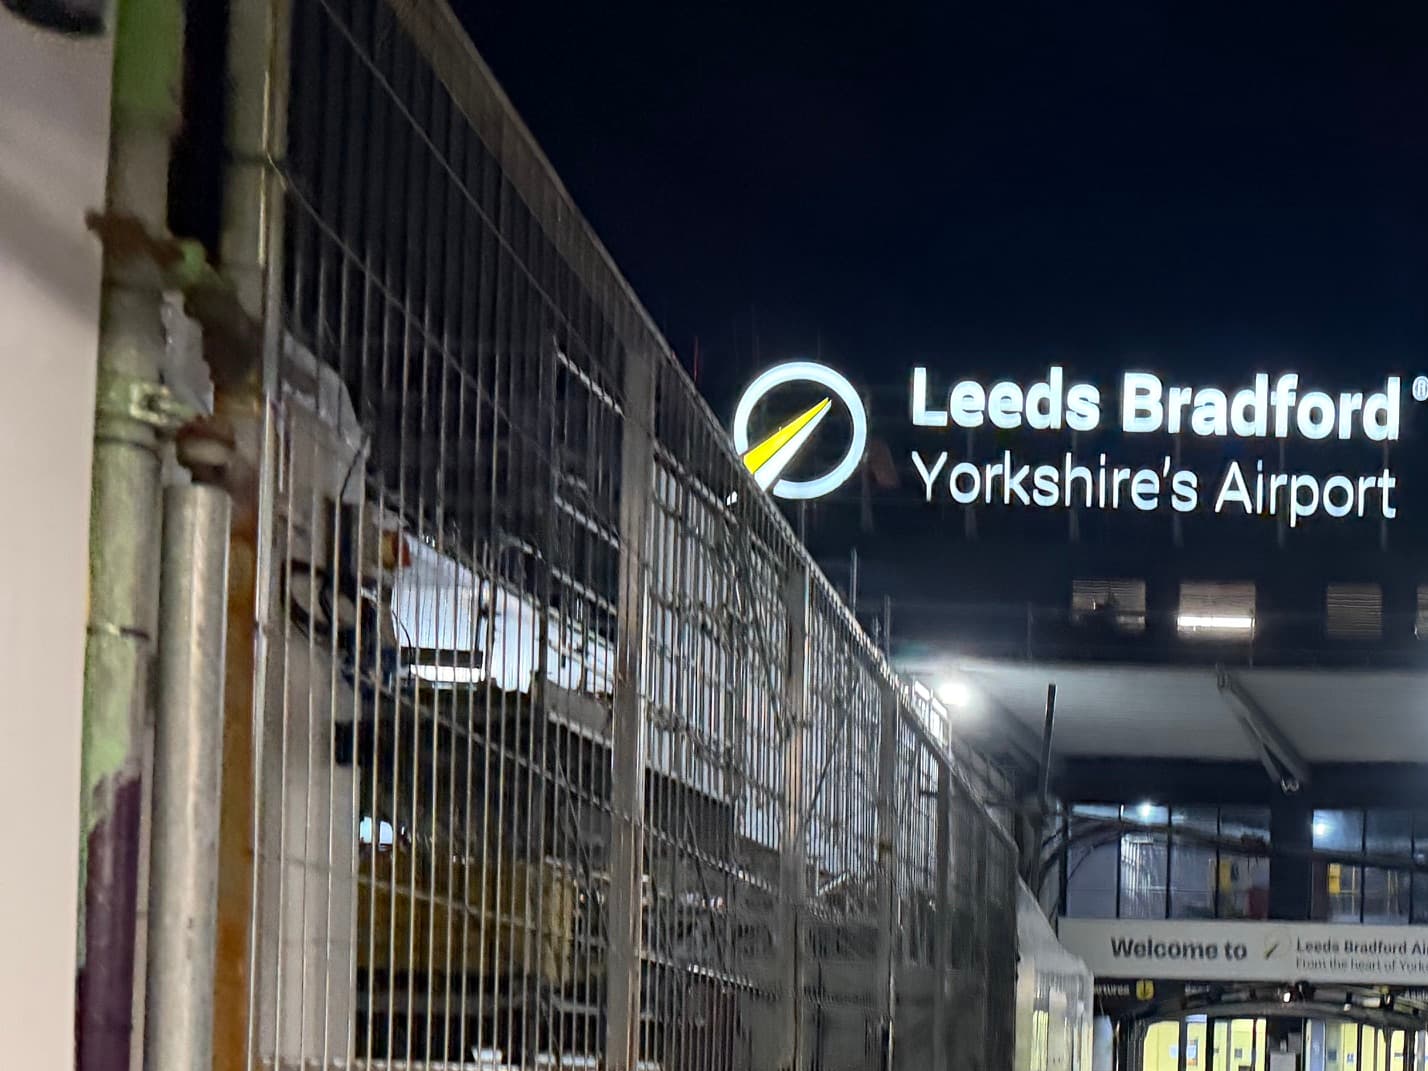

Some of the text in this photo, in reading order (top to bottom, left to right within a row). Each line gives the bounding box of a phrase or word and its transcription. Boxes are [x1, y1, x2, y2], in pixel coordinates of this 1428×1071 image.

[912, 366, 1102, 432] Leeds
[912, 450, 1397, 527] Yorkshire's Airport
[1110, 936, 1247, 961] Welcome to
[1296, 936, 1340, 953] Leeds
[1344, 938, 1407, 955] Bradford
[1296, 956, 1327, 969] From
[1329, 956, 1347, 970] the
[1350, 957, 1382, 971] heart
[1383, 958, 1396, 972] of
